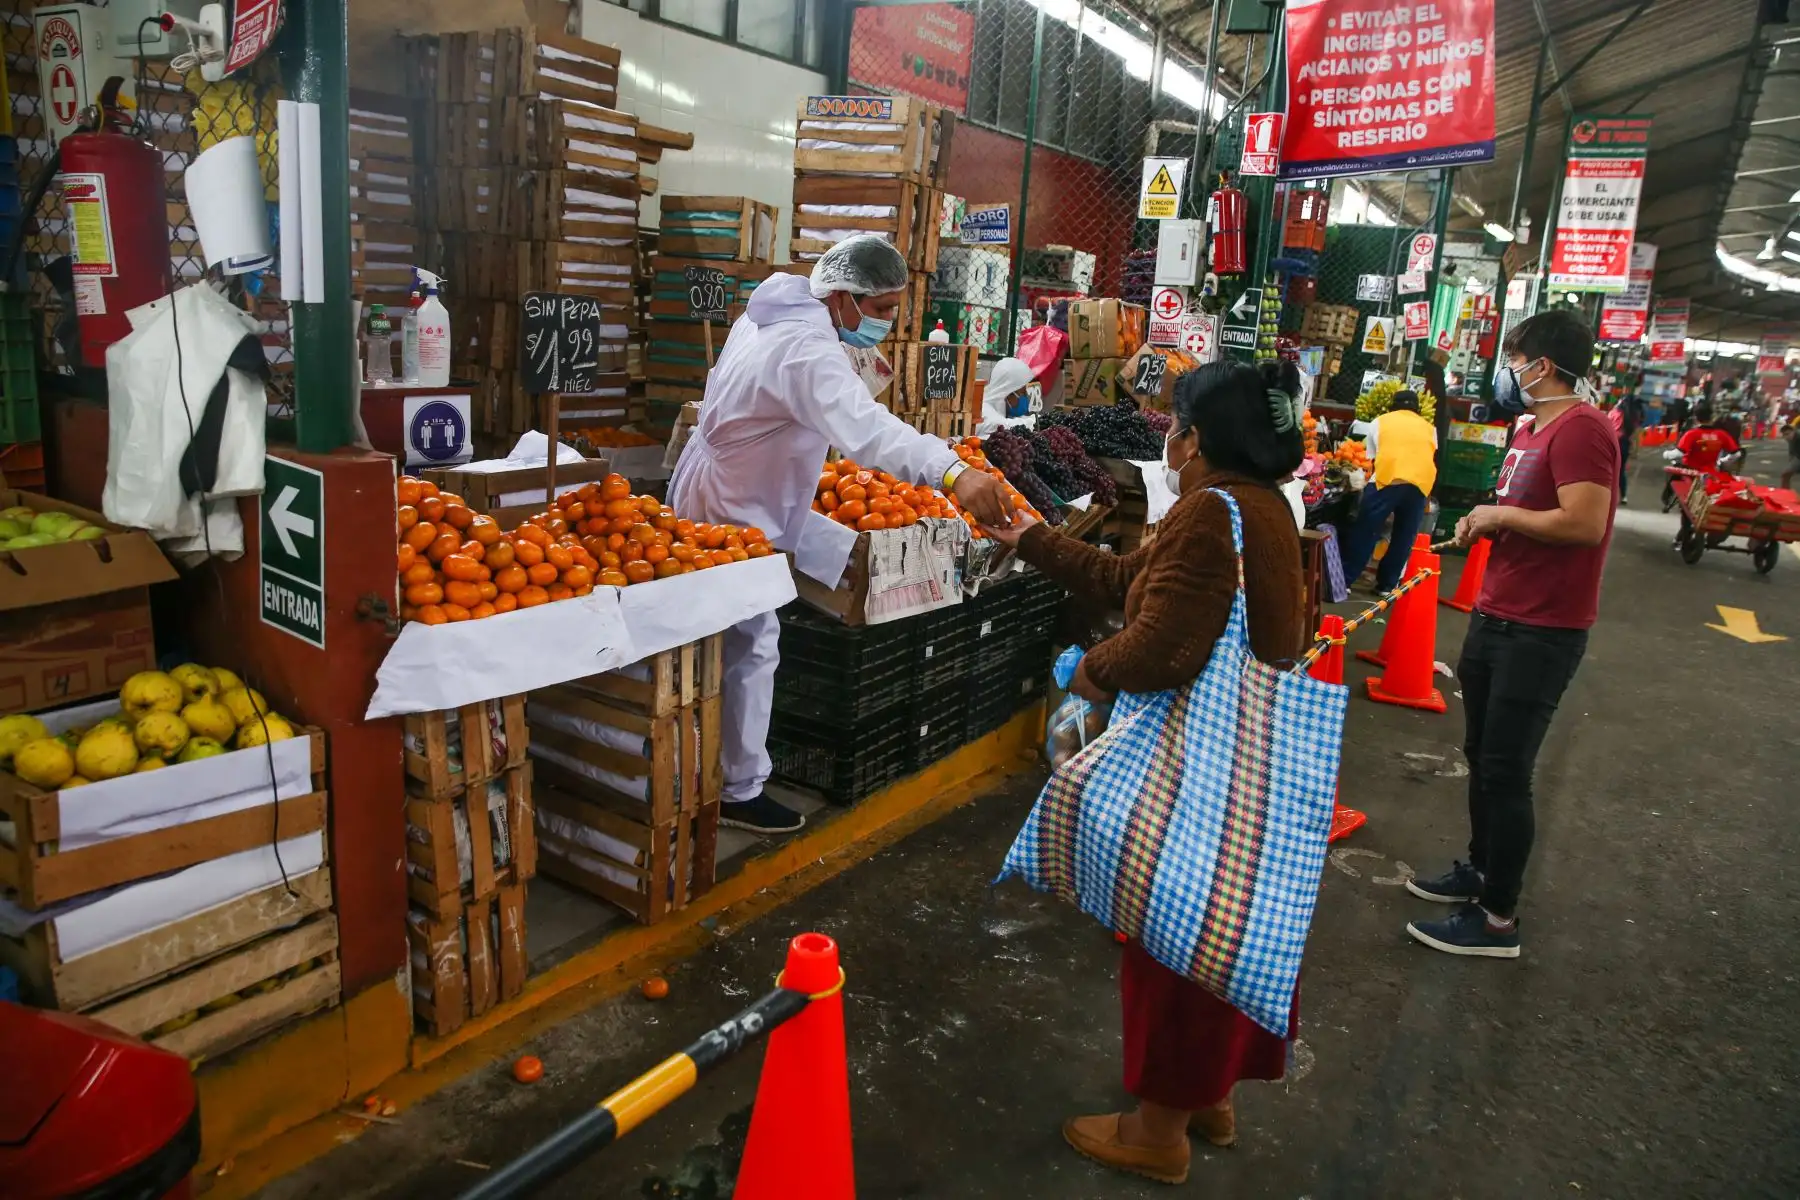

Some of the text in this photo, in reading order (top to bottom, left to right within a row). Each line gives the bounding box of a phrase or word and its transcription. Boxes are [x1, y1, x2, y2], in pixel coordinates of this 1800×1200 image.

[1341, 4, 1442, 30] EVITAR EL
[1324, 24, 1446, 54] INGRESO DE
[1396, 52, 1412, 70] Y
[1416, 38, 1485, 68] NIÑOS
[1310, 70, 1471, 106] PERSONAS CON
[1313, 96, 1454, 128] SÍNTOMAS DE
[1338, 122, 1428, 148] RESFRÍO
[1595, 183, 1608, 192] EL
[1563, 196, 1635, 206] COMERCIANTE
[962, 208, 1007, 225] AFORO
[980, 229, 1008, 240] PERSONAS
[689, 284, 725, 309] 0.80
[525, 296, 600, 329] SIN PEPA
[1222, 330, 1254, 343] ENTRADA
[930, 346, 950, 363] SIN
[927, 364, 957, 386] PEPA
[265, 581, 320, 631] ENTRADA
